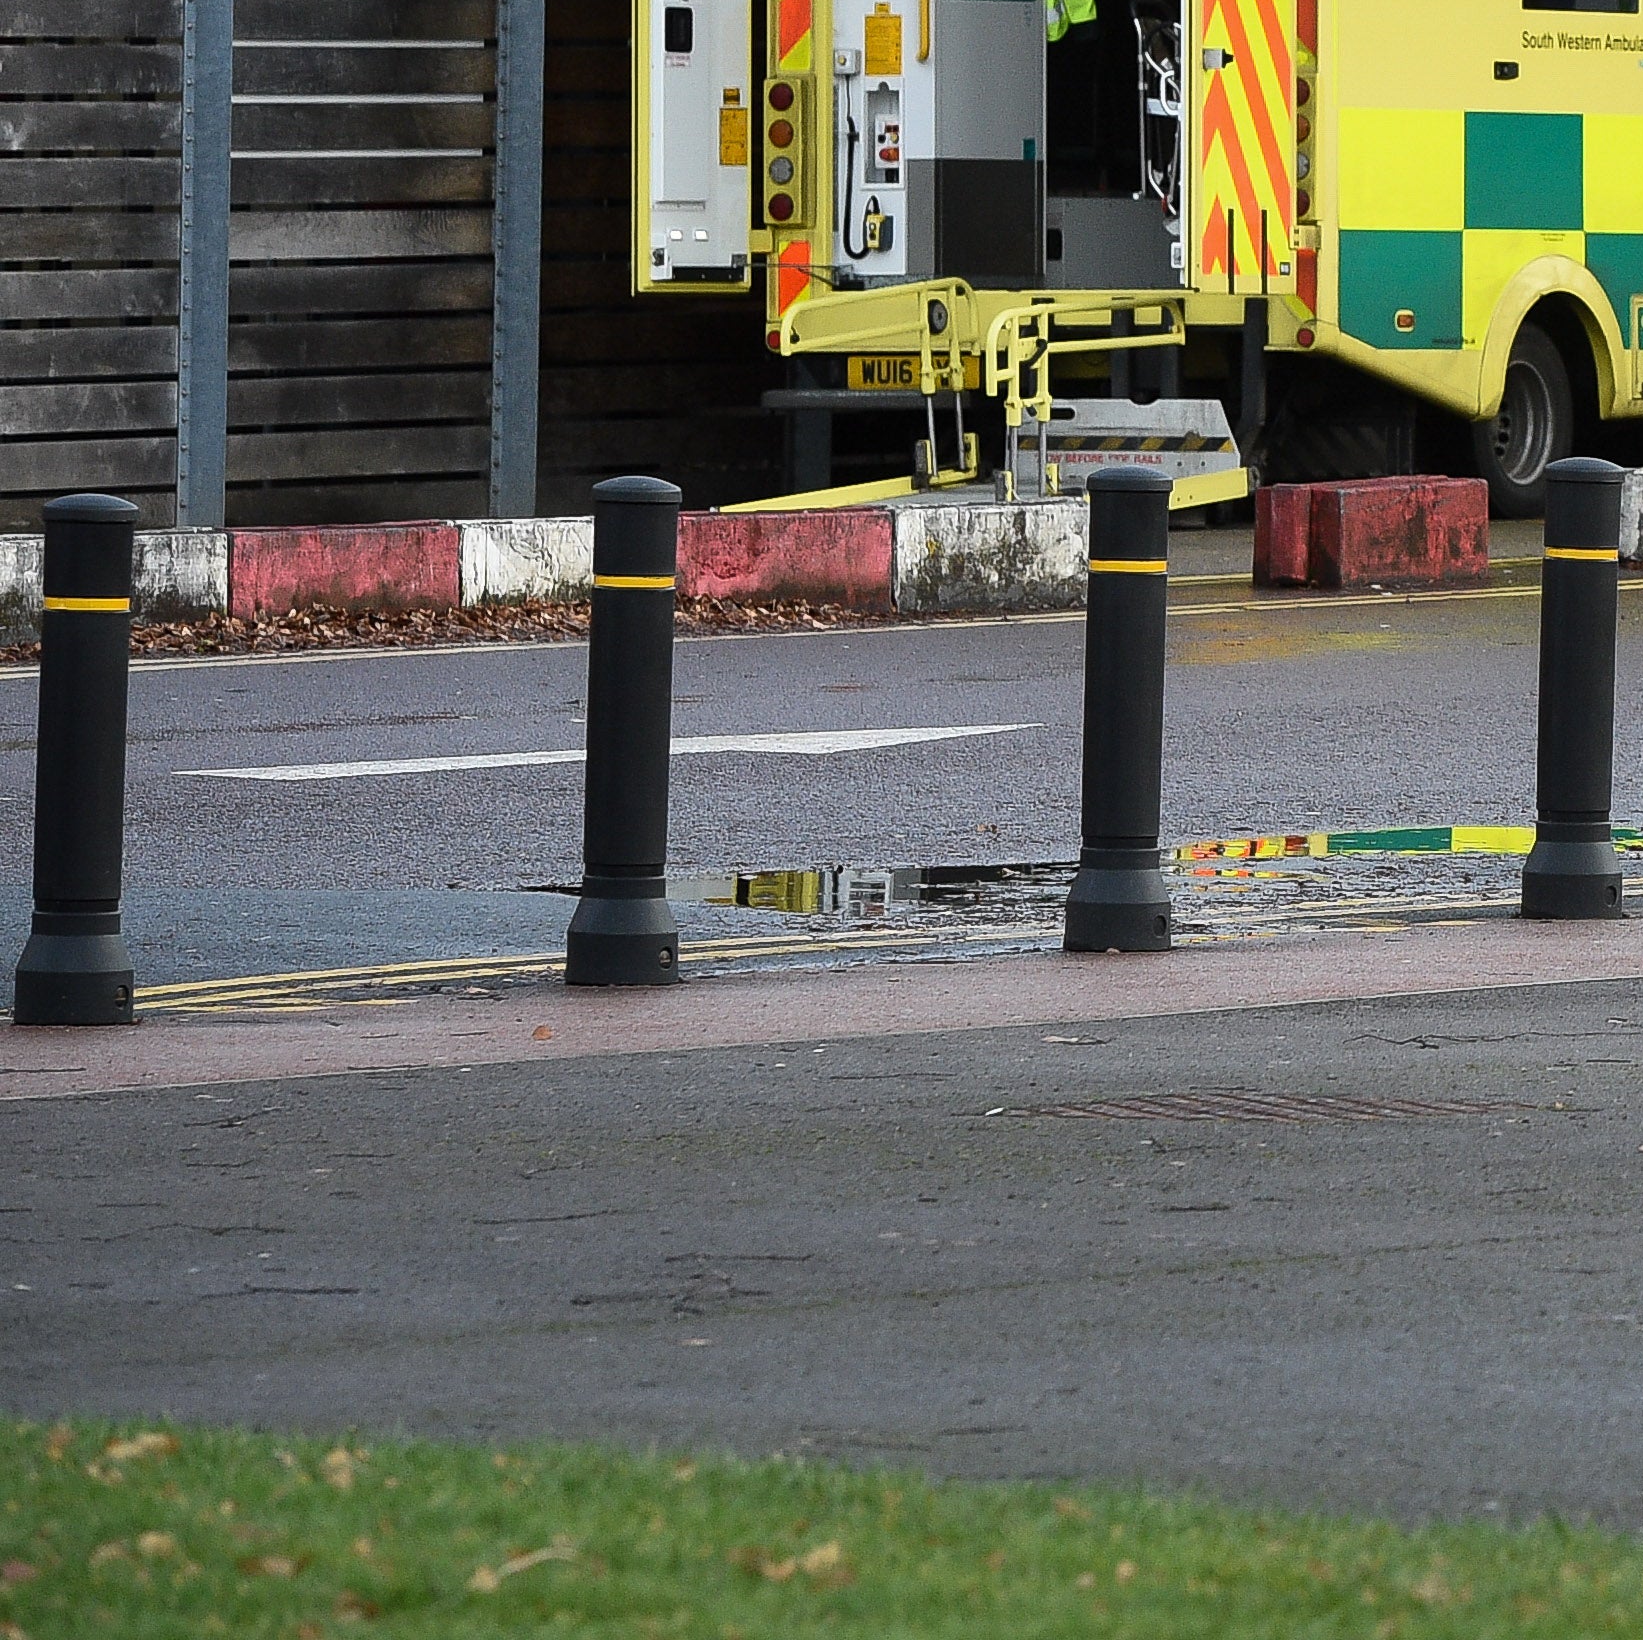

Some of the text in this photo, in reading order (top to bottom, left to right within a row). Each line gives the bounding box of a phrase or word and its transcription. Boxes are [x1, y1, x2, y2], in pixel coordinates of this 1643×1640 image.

[1522, 30, 1554, 49] South
[1557, 32, 1602, 51] Western
[862, 359, 913, 384] WU16
